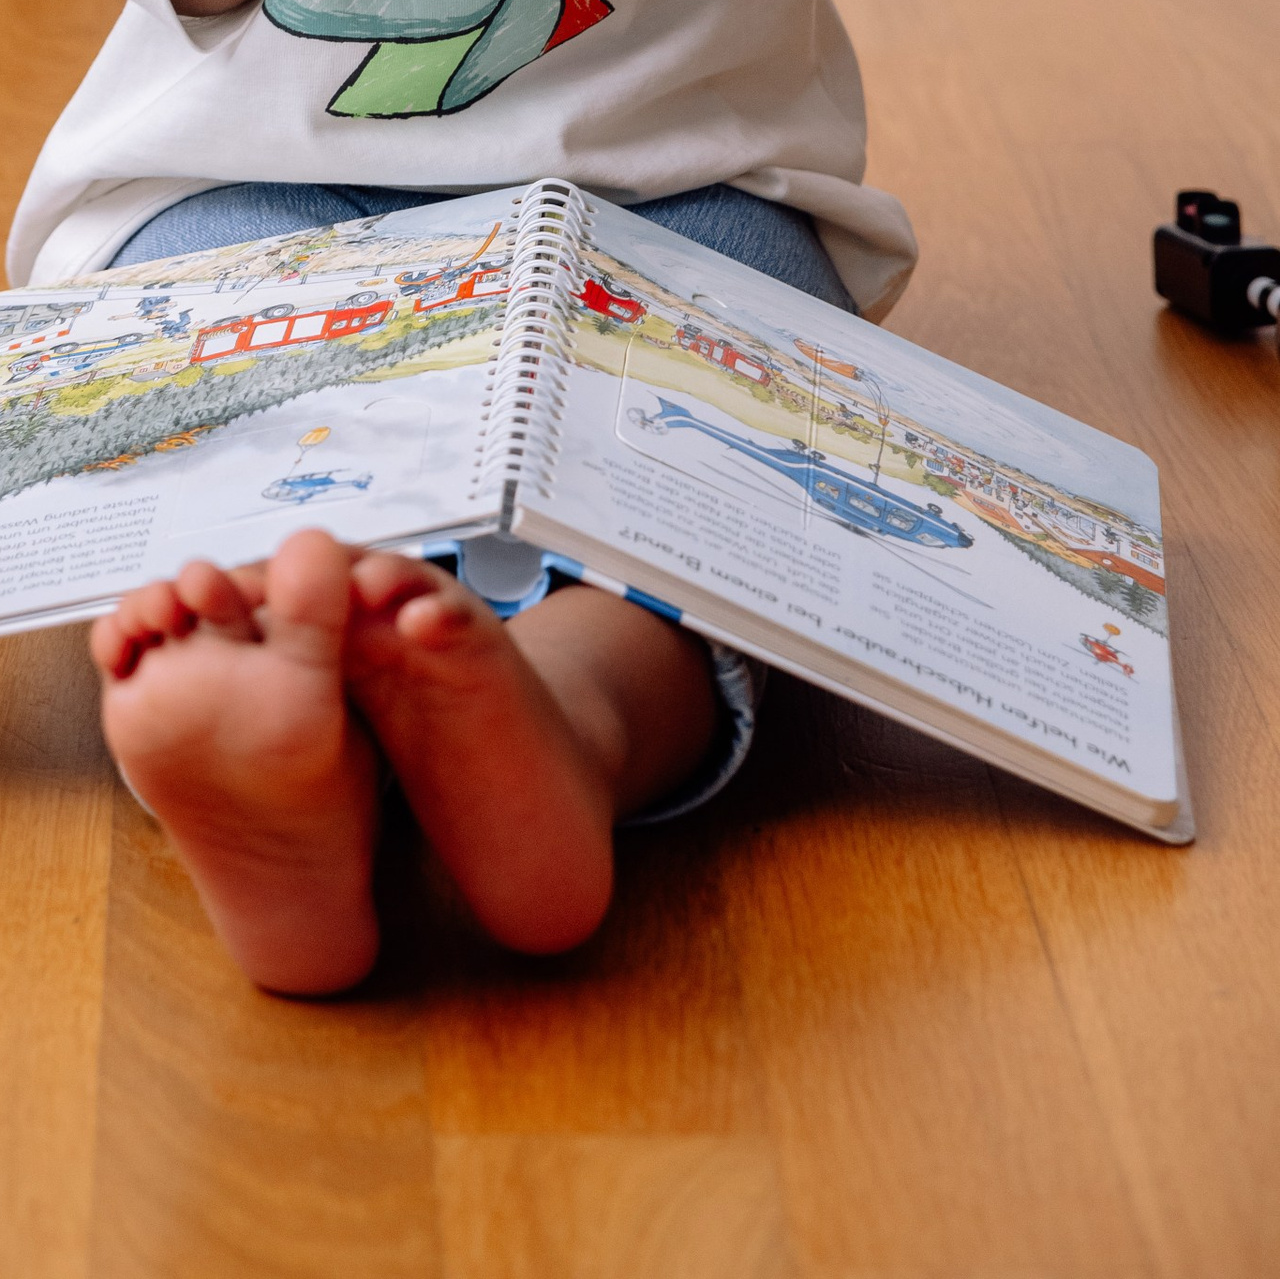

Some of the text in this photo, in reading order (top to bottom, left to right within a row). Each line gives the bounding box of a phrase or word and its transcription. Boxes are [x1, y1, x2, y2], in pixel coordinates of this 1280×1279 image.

[102, 493, 159, 509] nächste
[43, 505, 97, 520] Ladung
[55, 504, 156, 529] hubschrauber
[26, 525, 50, 534] um
[30, 531, 76, 546] Sofort
[42, 527, 151, 554] Wasserschwall
[99, 539, 147, 553] Boden
[69, 549, 95, 559] des
[120, 550, 144, 562] mit
[69, 556, 115, 570] einem
[105, 562, 141, 574] Über
[17, 566, 63, 582] Knopf
[67, 570, 100, 581] dem
[21, 577, 61, 590] Feuer
[618, 527, 1129, 772] Wie helfen Hubschrauber bei einem Brand?
